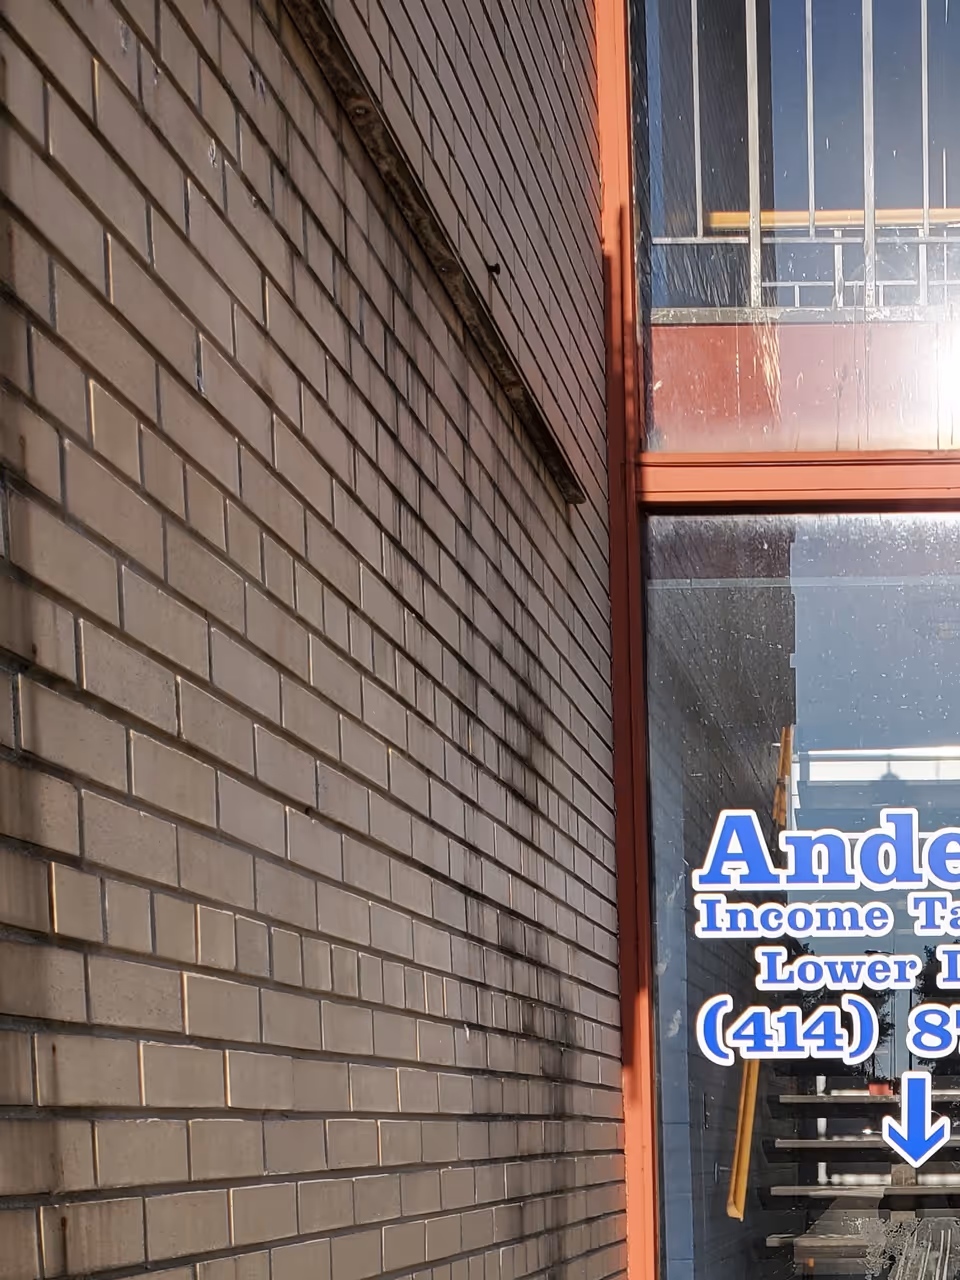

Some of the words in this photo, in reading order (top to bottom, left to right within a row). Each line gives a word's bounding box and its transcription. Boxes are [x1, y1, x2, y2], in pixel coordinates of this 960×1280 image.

[700, 896, 890, 935] Income
[760, 949, 919, 986] Lower
[700, 996, 876, 1061] (414)
